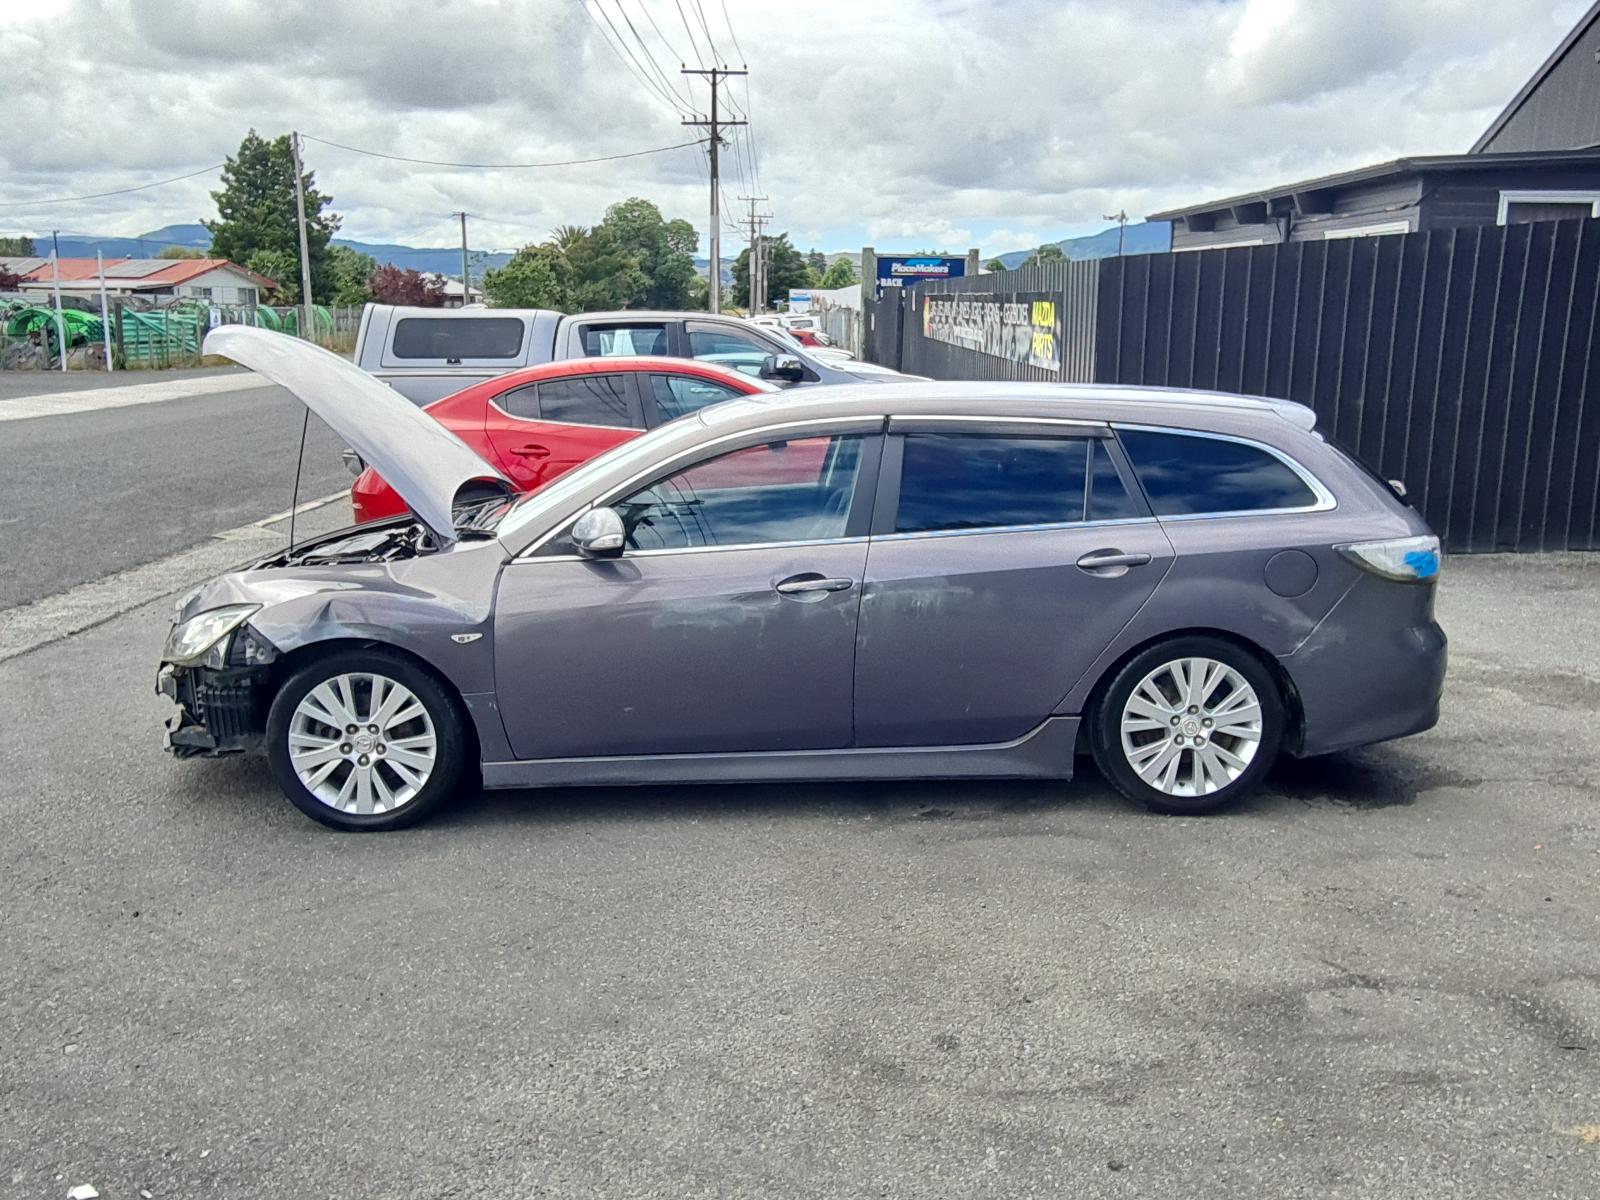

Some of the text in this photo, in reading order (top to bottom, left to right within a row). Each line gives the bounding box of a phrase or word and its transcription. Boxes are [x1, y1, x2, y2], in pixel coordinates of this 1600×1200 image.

[891, 263, 949, 273] PlaceMakers
[1032, 301, 1055, 327] MAZDA
[1032, 332, 1054, 361] PARTS
